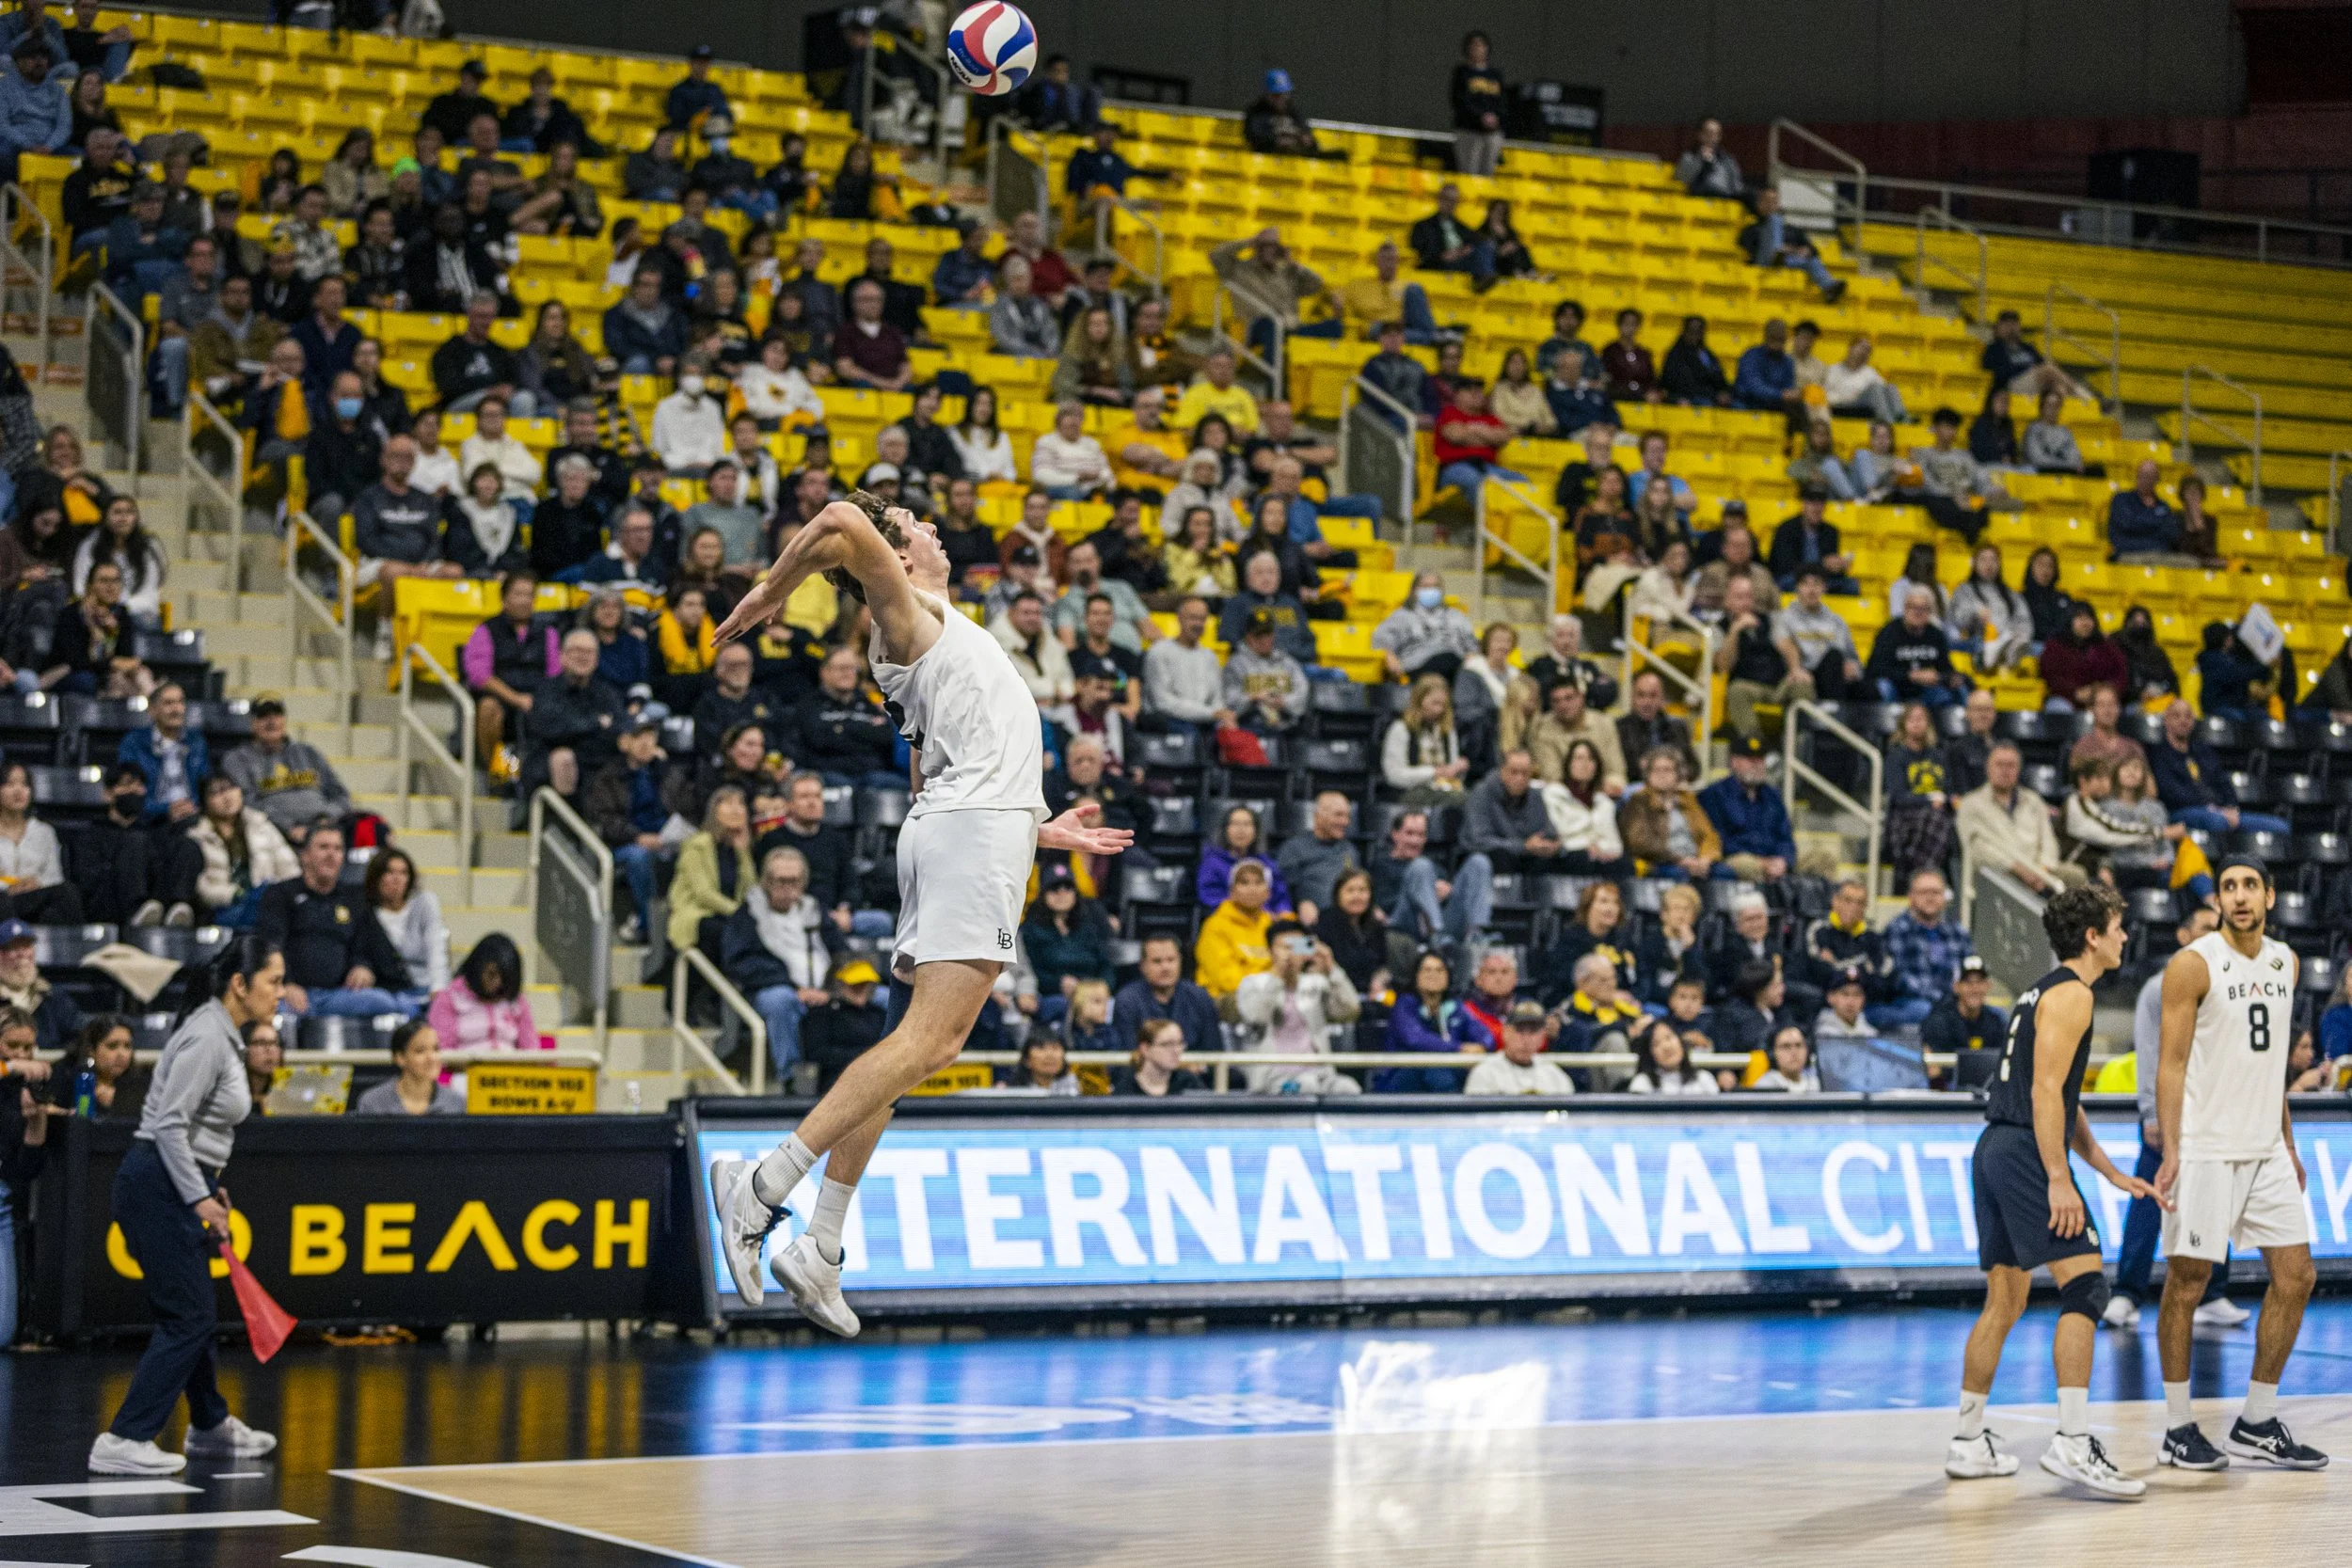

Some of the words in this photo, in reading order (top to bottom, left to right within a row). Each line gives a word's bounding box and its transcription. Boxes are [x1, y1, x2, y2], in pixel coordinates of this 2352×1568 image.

[950, 56, 972, 84] NCAA
[996, 927, 1013, 949] LB
[2227, 982, 2287, 1001] BEACH
[2249, 1003, 2271, 1052] 8
[478, 1075, 551, 1089] SECTION
[710, 1138, 1812, 1273] NTERNATIONAL
[1820, 1140, 1980, 1254] CIT
[290, 1199, 650, 1275] BEACH
